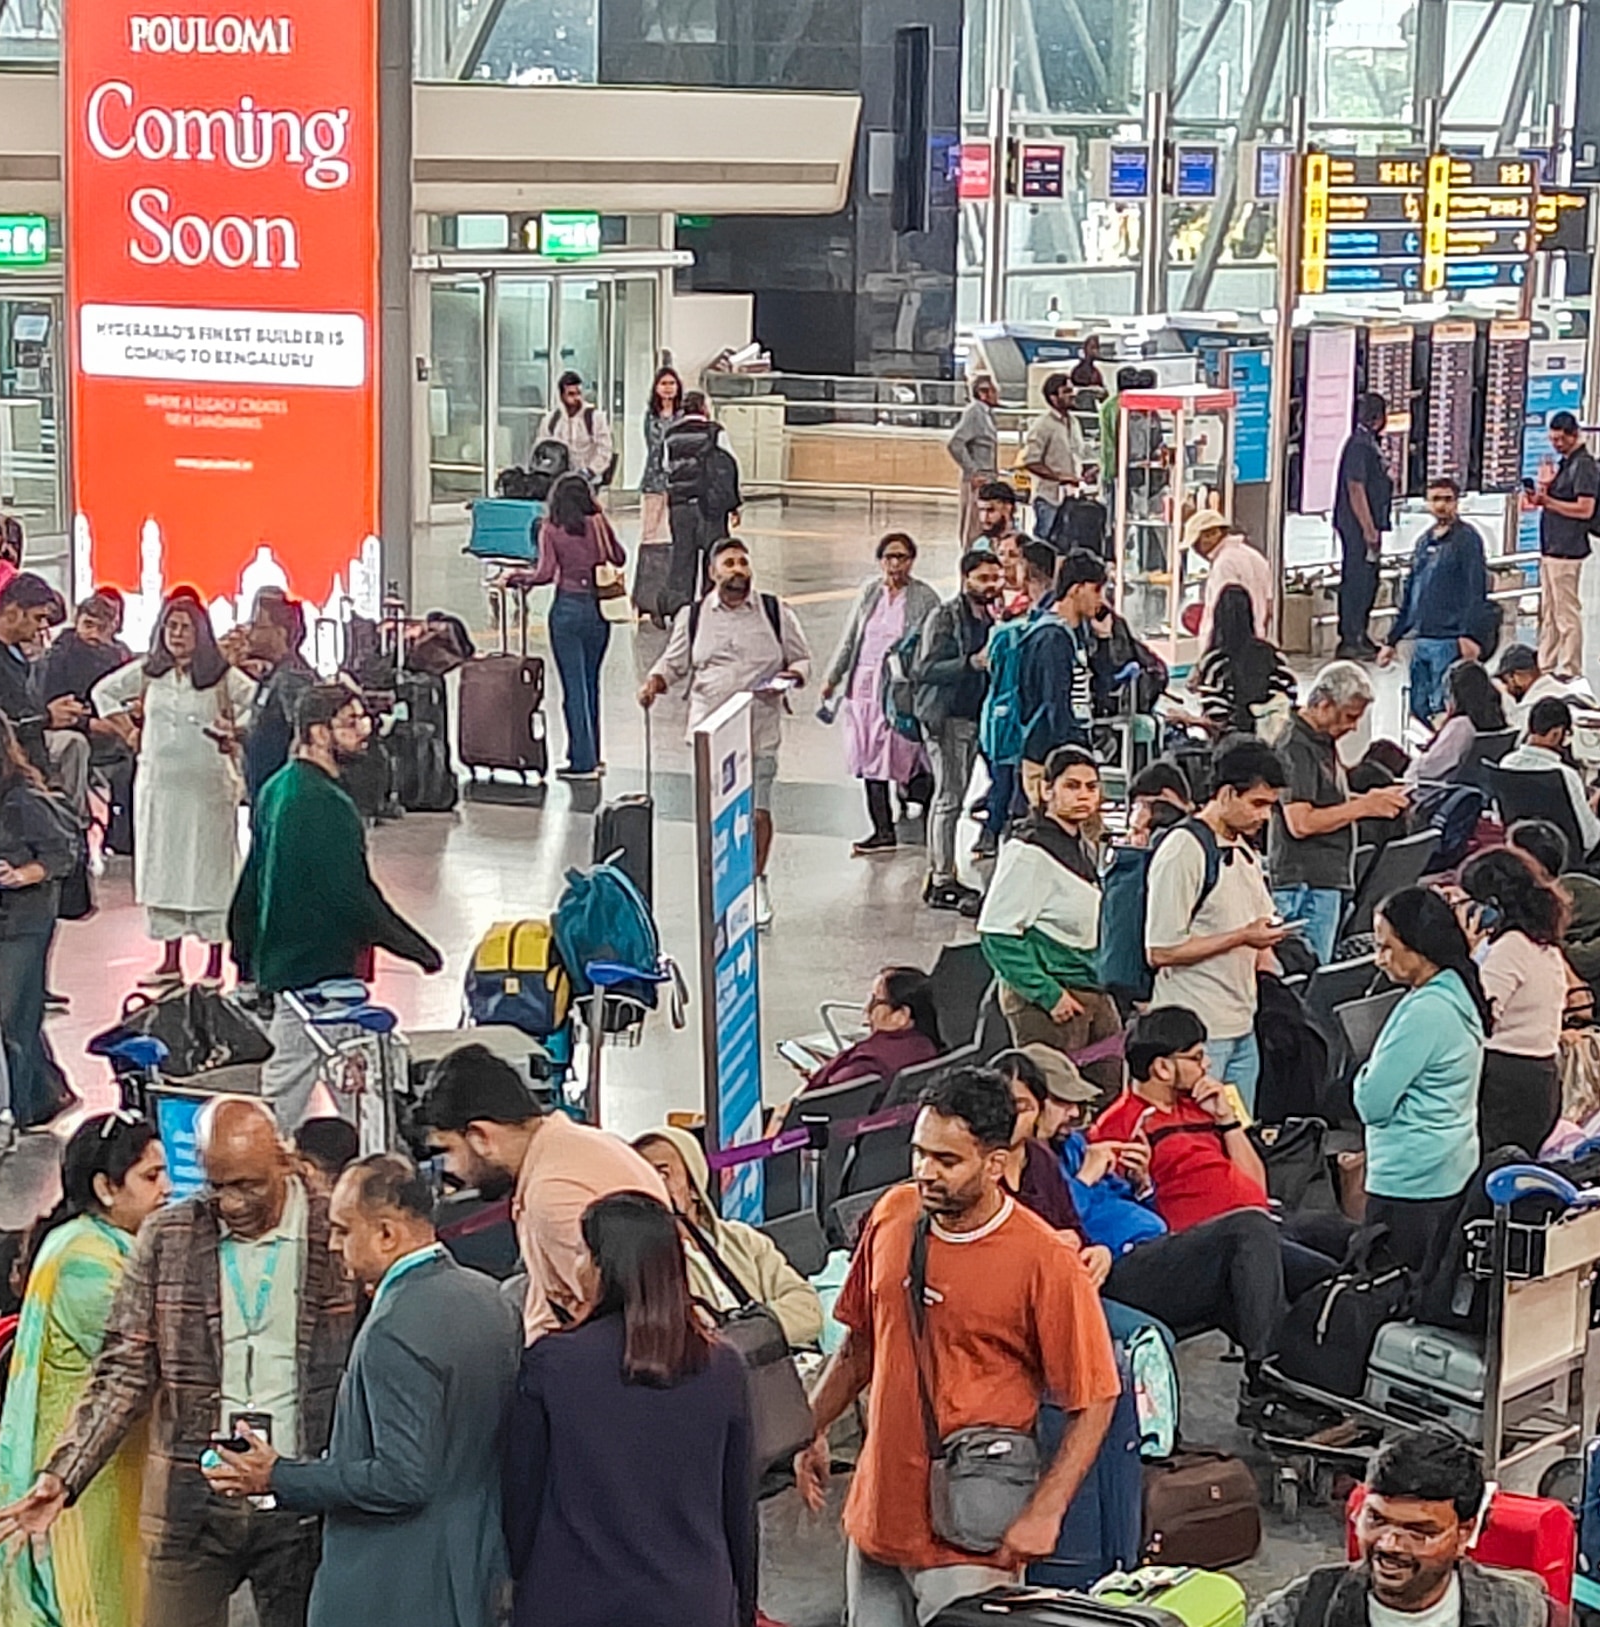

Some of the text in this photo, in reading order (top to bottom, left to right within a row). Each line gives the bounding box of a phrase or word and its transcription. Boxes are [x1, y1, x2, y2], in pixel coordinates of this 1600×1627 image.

[131, 17, 292, 54] POULOMI
[87, 80, 351, 190] Coming
[127, 187, 300, 270] Soon
[199, 326, 251, 343] FINEST
[256, 328, 324, 345] BUILDER
[328, 330, 345, 346] IS
[125, 345, 314, 367] COMING TO BENGALURU
